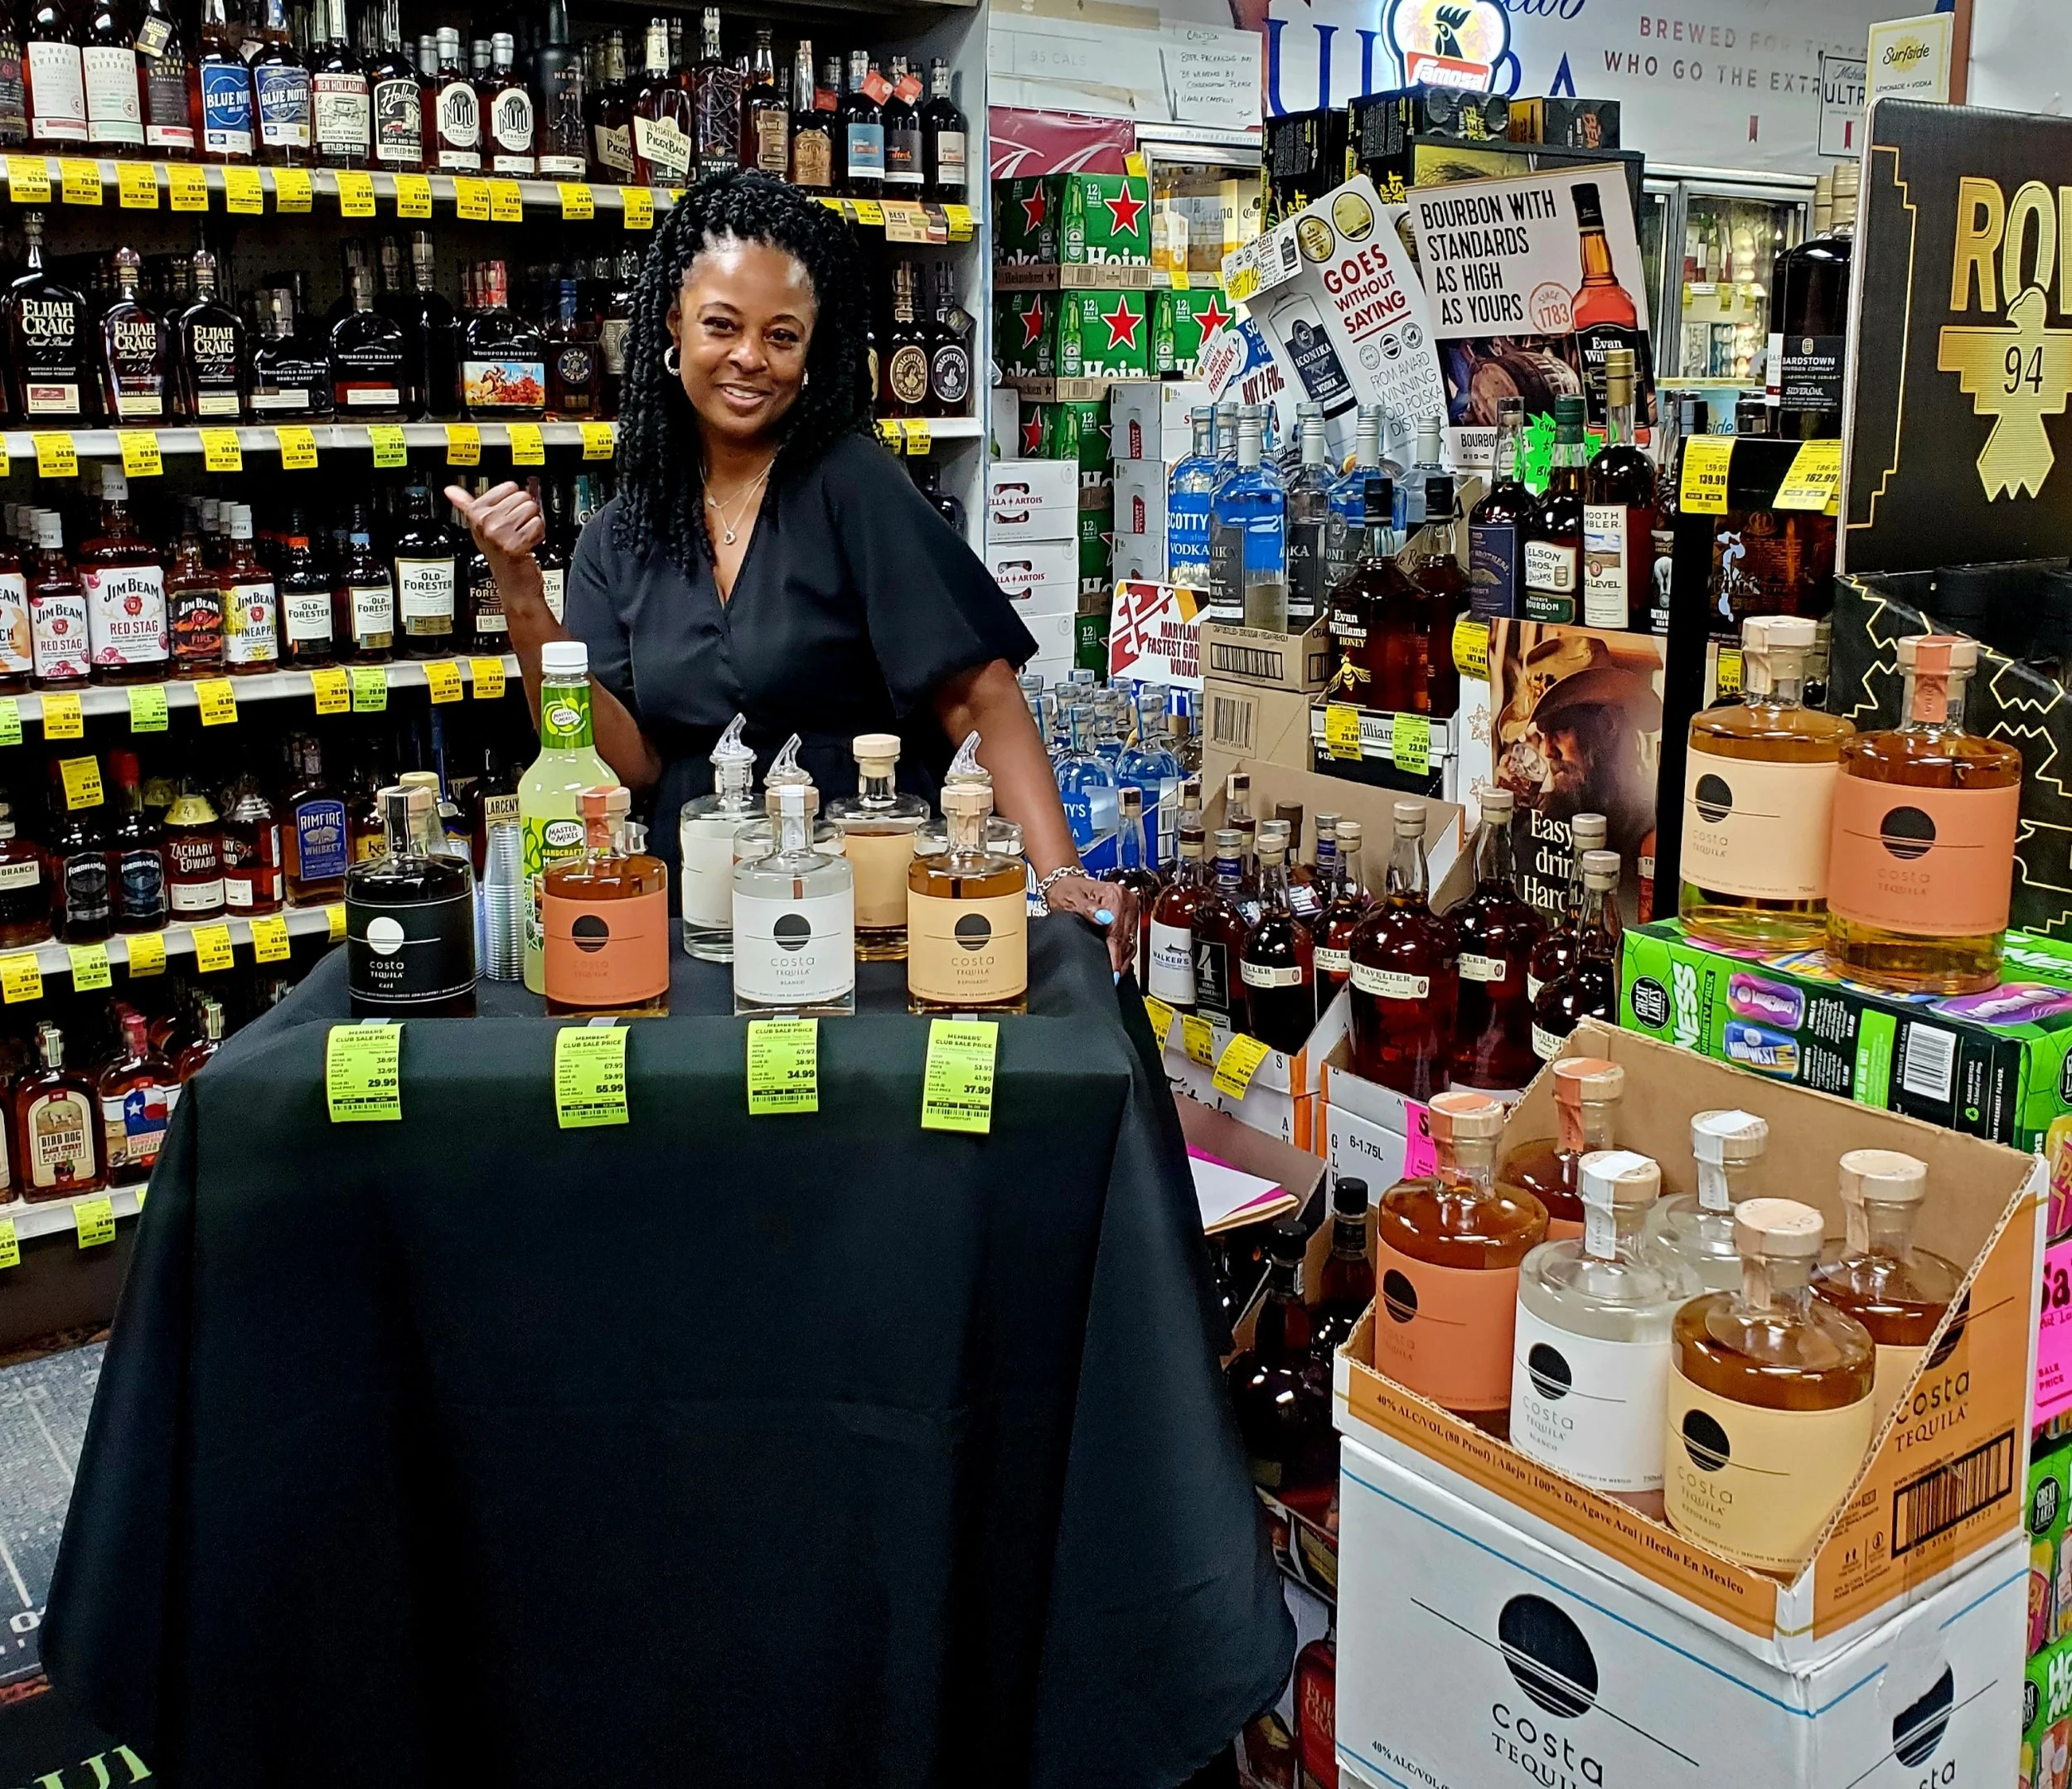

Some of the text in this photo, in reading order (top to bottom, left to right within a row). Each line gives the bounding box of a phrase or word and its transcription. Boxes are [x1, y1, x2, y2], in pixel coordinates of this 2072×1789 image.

[1187, 31, 1219, 41] CAUTION
[1639, 16, 1736, 48] BREWED
[1750, 32, 1791, 52] FOR
[1882, 44, 1930, 65] Surfside
[1604, 50, 1758, 90] WHO GO THE
[206, 93, 235, 109] BLUE
[261, 86, 308, 104] BLUE NOTE
[443, 100, 476, 128] NULU
[498, 104, 531, 133] NULU
[1087, 184, 1099, 195] 12
[888, 211, 906, 221] BEST
[1420, 189, 1557, 230] BOURBON WITH
[1427, 226, 1530, 261] STANDARDS
[1324, 244, 1387, 294] GOES
[1436, 262, 1503, 294] AS HIGH
[1334, 270, 1396, 313] WITHOUT
[22, 298, 75, 318] ELIJAH
[1084, 300, 1096, 311] 12
[1176, 300, 1188, 311] 12
[1343, 290, 1406, 334] SAYING
[1442, 293, 1523, 325] AS YOURS
[1537, 303, 1570, 329] 1783
[22, 317, 75, 337] CRAIG
[114, 321, 156, 337] ELIJAH
[194, 325, 233, 340] ELIJAH
[114, 334, 156, 351] CRAIG
[194, 338, 234, 355] CRAIG
[1592, 337, 1623, 349] Evan
[1208, 348, 1222, 373] MADE IN
[1295, 344, 1332, 368] ICONIKA
[1208, 346, 1236, 395] FREDERICK
[1370, 351, 1431, 390] FROM AWARD
[2002, 345, 2044, 395] 94
[1260, 372, 1268, 400] 2
[1377, 368, 1437, 405] WINNING
[1385, 385, 1444, 422] OLD POLSKA
[1704, 463, 1727, 473] 159.99
[1699, 473, 1726, 486] 139.99
[1805, 473, 1837, 483] 162.99
[1015, 497, 1043, 505] ARTOIS
[1082, 521, 1094, 531] 12
[1170, 543, 1210, 556] VODKA
[404, 579, 453, 591] FORESTER
[420, 572, 440, 581] OLD
[1019, 573, 1045, 582] ARTOIS
[104, 579, 159, 603] JIM BEAM
[178, 599, 219, 616] JIM BEAM
[235, 592, 274, 612] JIM BEAM
[302, 602, 318, 611] OLD
[371, 597, 385, 605] OLD
[36, 604, 83, 624] JIM BEAM
[288, 608, 330, 618] FORESTER
[1334, 610, 1358, 624] Evan
[110, 620, 158, 635] RED STAG
[235, 625, 277, 638] PINEAPPLE
[1082, 626, 1093, 636] 12
[1329, 623, 1367, 638] Williams
[41, 639, 82, 652] RED STAG
[1147, 637, 1182, 657] FASTEST
[1339, 637, 1366, 648] HONEY
[1170, 657, 1198, 679] VODKA
[1408, 742, 1428, 753] 23.99
[487, 798, 519, 816] LARCENY
[300, 812, 342, 830] RIMFIRE
[1531, 808, 1574, 851] Easy
[548, 825, 577, 839] MASTER
[556, 831, 579, 843] MIXES
[1692, 830, 1728, 846] costa
[170, 841, 213, 860] ZACHARY
[1692, 844, 1727, 858] TEQUILA
[2, 864, 35, 877] BRANCH
[180, 856, 216, 872] EDWARD
[1877, 867, 1931, 884] costa
[1877, 883, 1929, 896] TEQUILA
[370, 960, 404, 970] costa
[573, 960, 608, 970] costa
[771, 955, 815, 967] costa
[951, 955, 995, 966] costa
[1153, 951, 1188, 966] WALKER'S
[1197, 944, 1218, 981] 4
[370, 971, 403, 979] TEQUILA
[776, 968, 811, 977] TEQUILA
[956, 968, 990, 977] TEQUILA
[1356, 964, 1411, 984] TRAVELLER
[1636, 983, 1649, 1017] GREAT
[1648, 987, 1662, 1022] LAKES
[1701, 973, 1716, 1054] VARIETY PACK
[1729, 1041, 1777, 1065] MIDWEST
[787, 1070, 816, 1079] 34.99
[368, 1079, 397, 1088] 29.99
[596, 1084, 623, 1093] 55.99
[964, 1084, 990, 1094] 37.99
[41, 1131, 81, 1148] BIRD DOG
[1349, 1133, 1384, 1161] 6-1.75L
[2038, 1363, 2060, 1378] SALE
[2039, 1374, 2064, 1391] PRICE
[1523, 1395, 1574, 1431] costa
[1525, 1414, 1566, 1442] TEQUILA
[1895, 1408, 1968, 1452] TEQUILA
[1677, 1466, 1733, 1505] costa
[2036, 1482, 2056, 1505] GREAT
[1376, 1393, 1745, 1596] 40% ALC/VOL (80 Proof) Añejo 100% De Agave Azul Hecho En Mexico
[1681, 1486, 1726, 1516] TEQUILA
[2036, 1498, 2055, 1521] LAKES
[1372, 1740, 1392, 1760] 40%
[1492, 1703, 1603, 1787] costa
